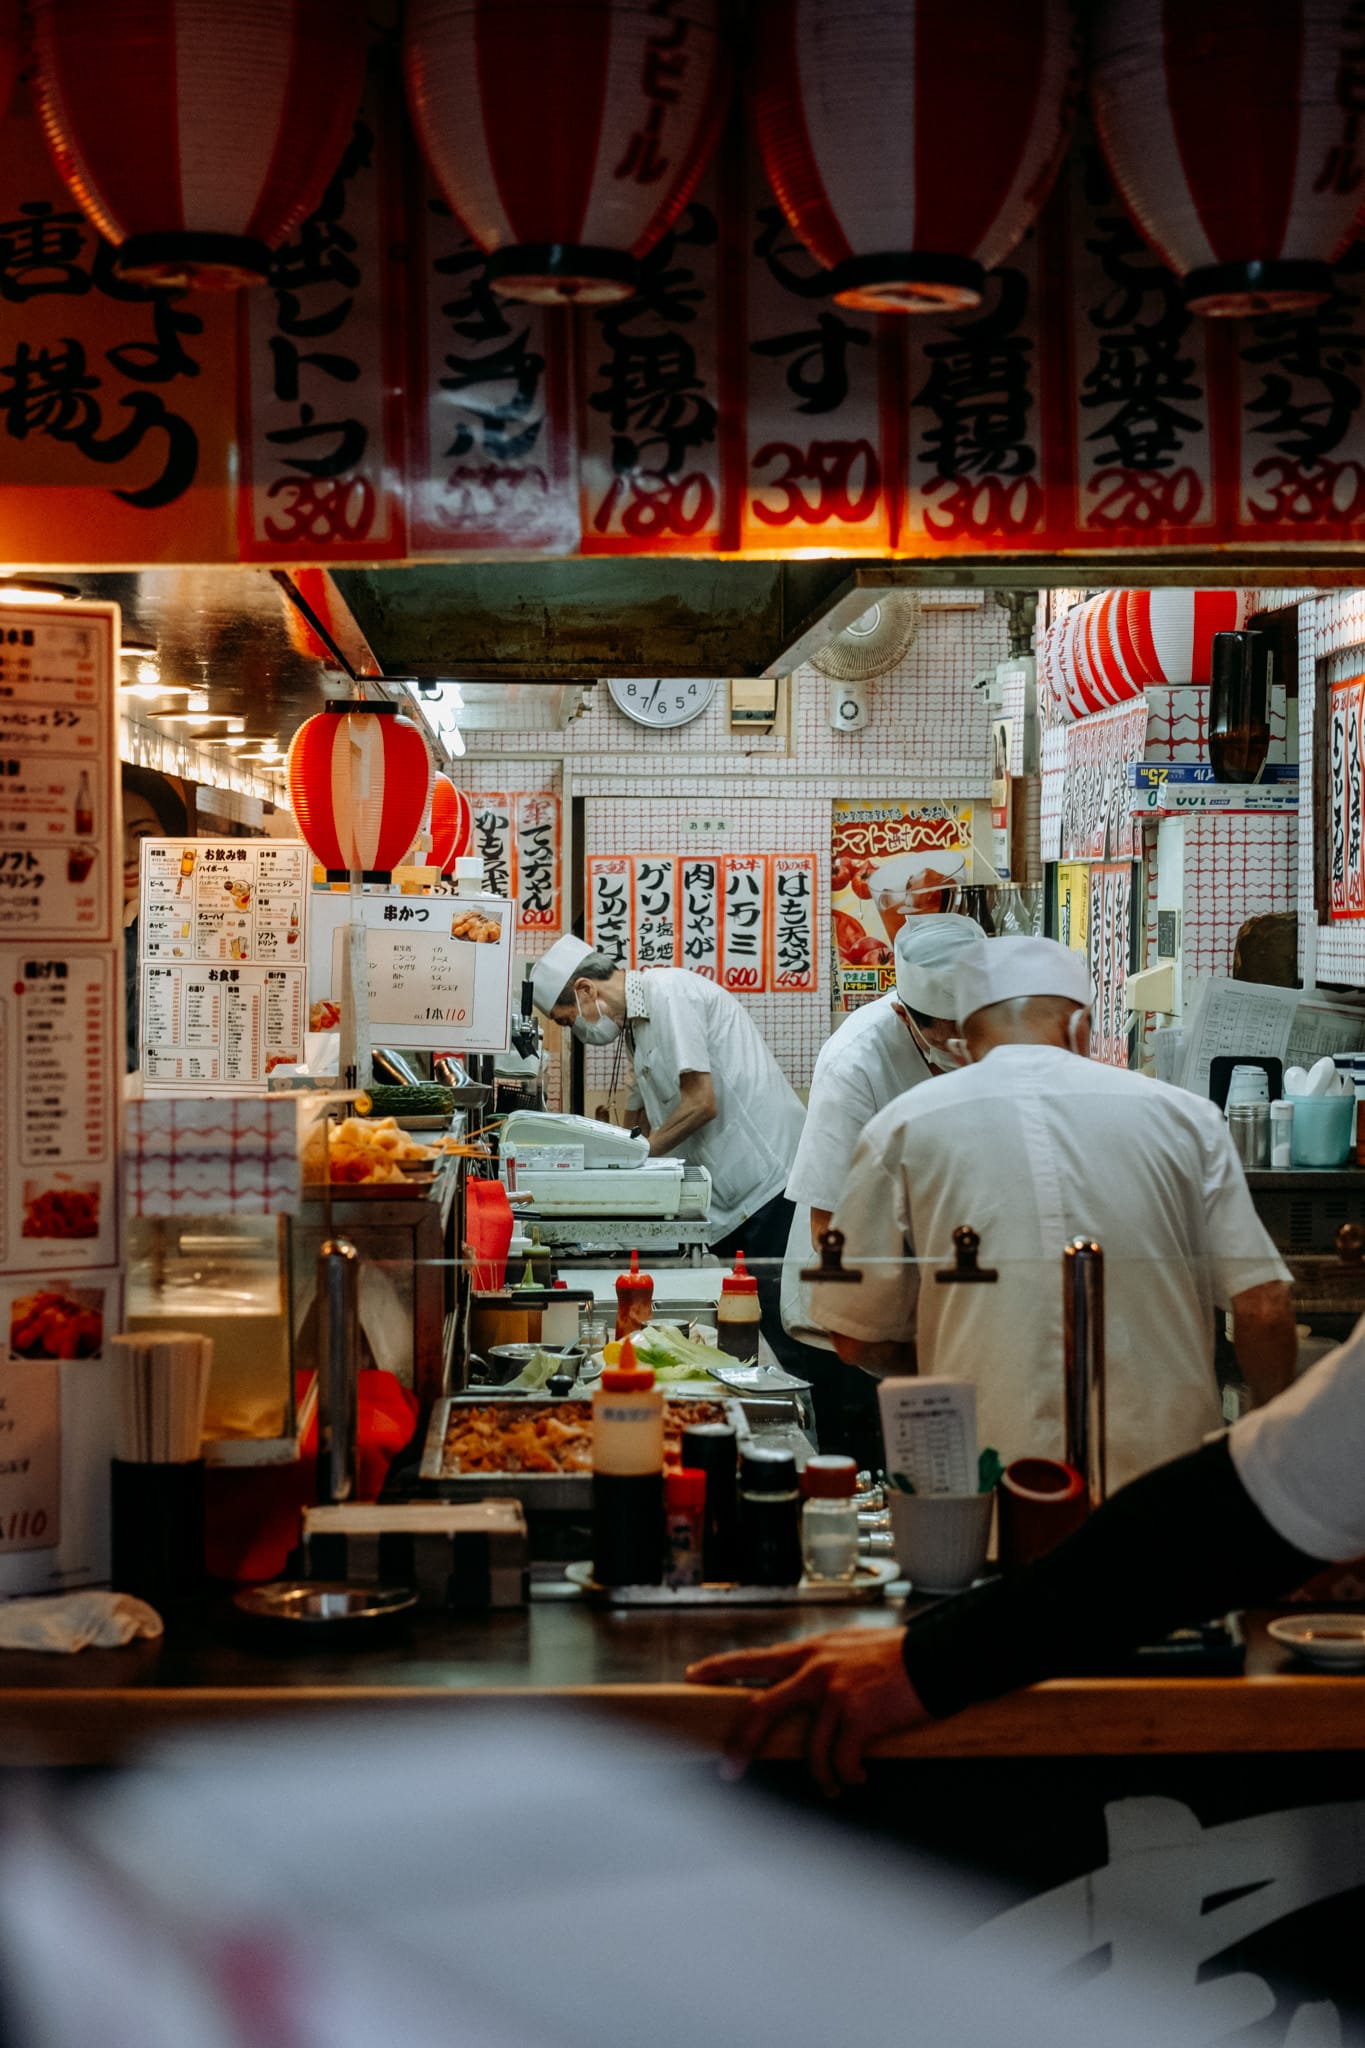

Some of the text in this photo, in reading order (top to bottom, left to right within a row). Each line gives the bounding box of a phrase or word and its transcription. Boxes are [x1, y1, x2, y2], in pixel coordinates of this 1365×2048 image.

[1087, 467, 1203, 531] 280
[1249, 458, 1365, 524] 380
[263, 475, 375, 545] 380
[595, 473, 714, 537] 180
[921, 474, 1045, 541] 300
[626, 683, 637, 696] 8
[687, 684, 698, 696] 4
[640, 696, 649, 709] 7
[657, 701, 667, 714] 6
[675, 696, 685, 709] 5
[689, 821, 726, 831] お手洗
[204, 848, 247, 861] お飲み物
[198, 913, 225, 921] チューハイ
[383, 904, 430, 922] 串かつ
[596, 876, 630, 963] しめさば
[684, 863, 715, 959] 肉じゃが
[726, 874, 761, 956] ハラミ
[257, 932, 276, 940] ソフト
[208, 968, 240, 982] お食事
[725, 966, 758, 986] 600
[776, 969, 811, 987] 450
